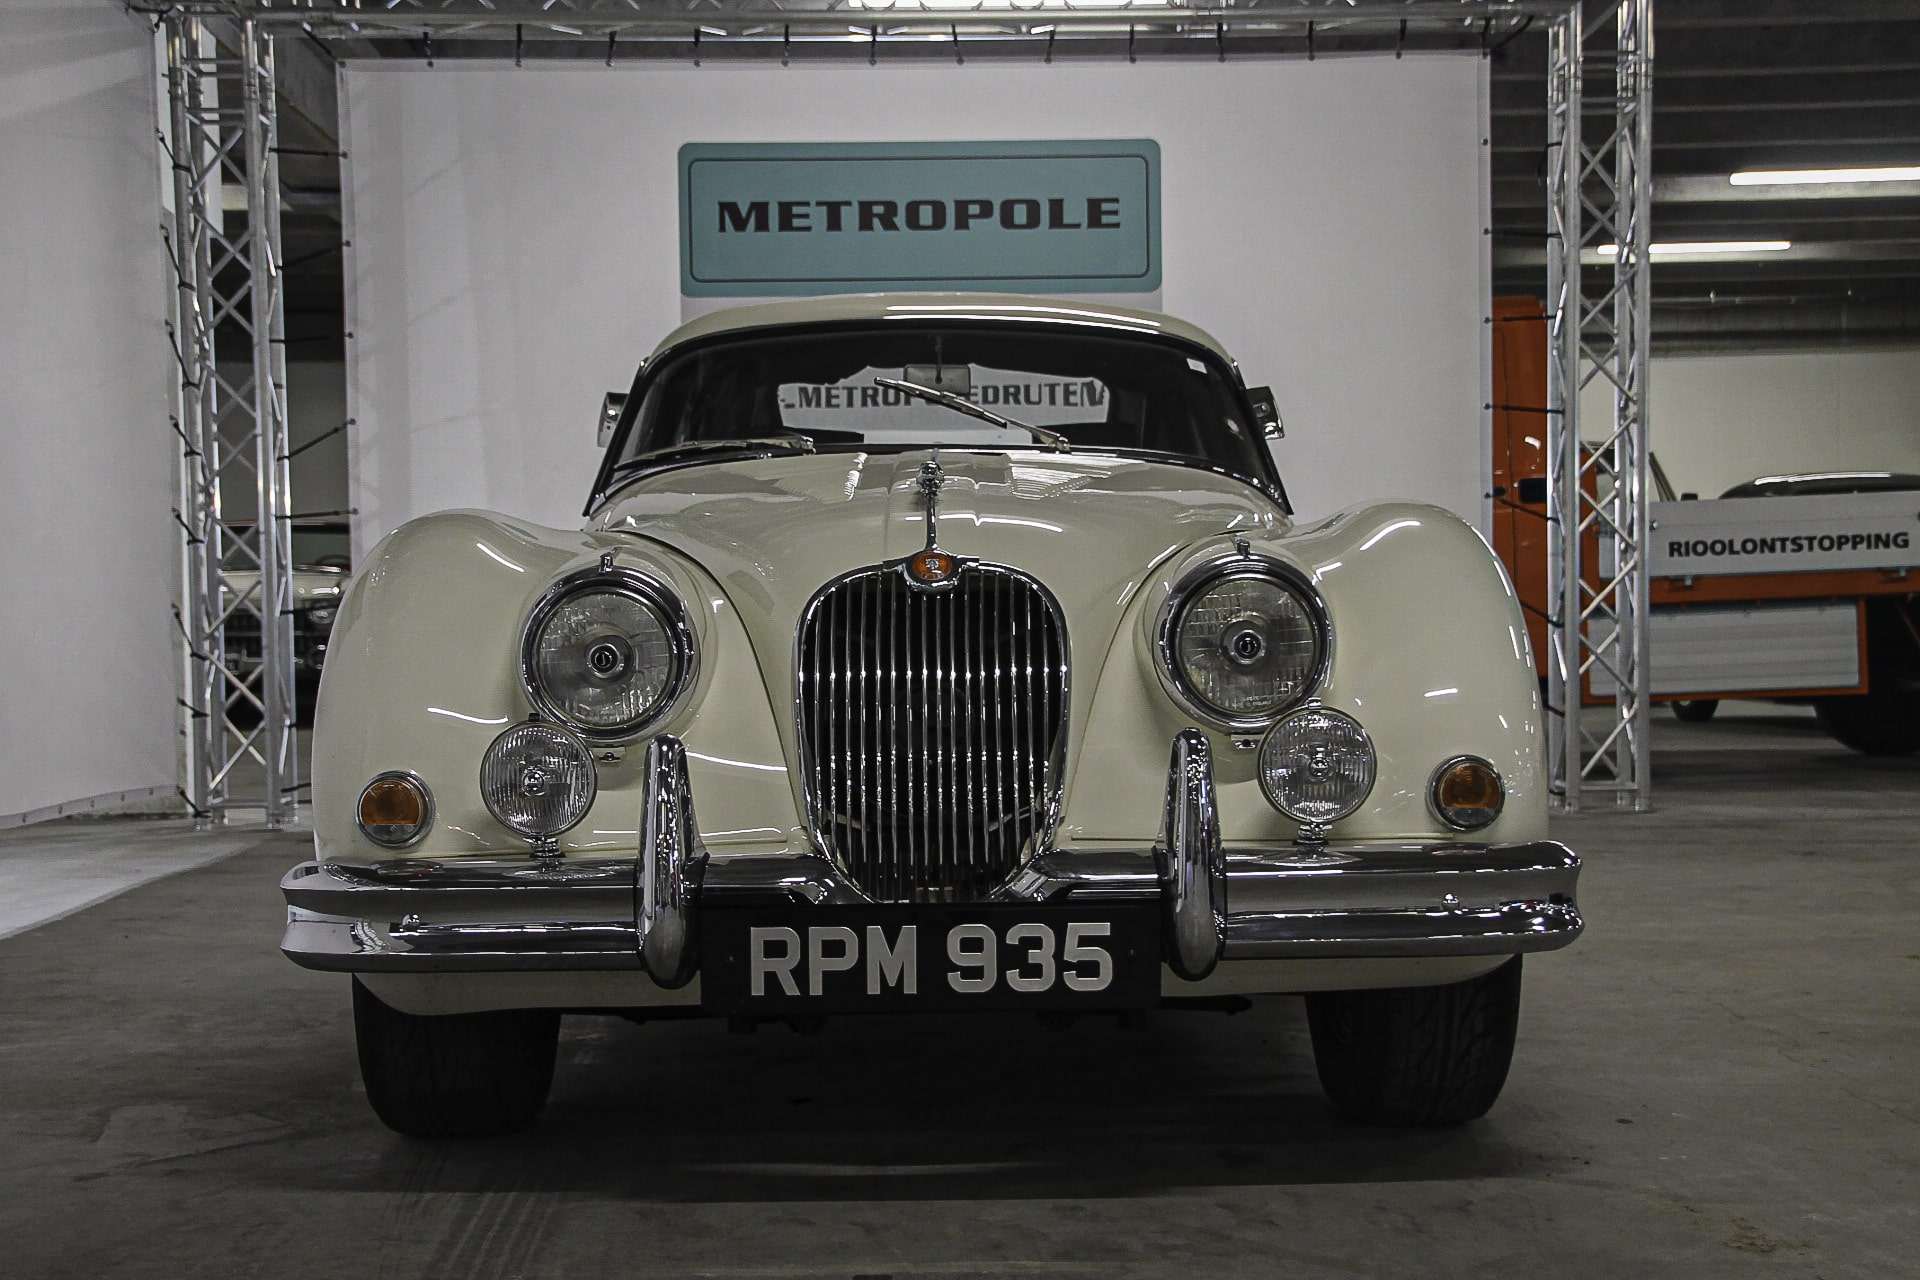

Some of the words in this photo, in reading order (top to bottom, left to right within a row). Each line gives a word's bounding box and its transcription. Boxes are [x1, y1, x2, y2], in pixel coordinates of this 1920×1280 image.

[718, 198, 1121, 233] METROPOLE
[1668, 531, 1910, 558] RIOOLONTSTOPPING
[750, 925, 917, 996] RPM
[946, 922, 1113, 993] 935
